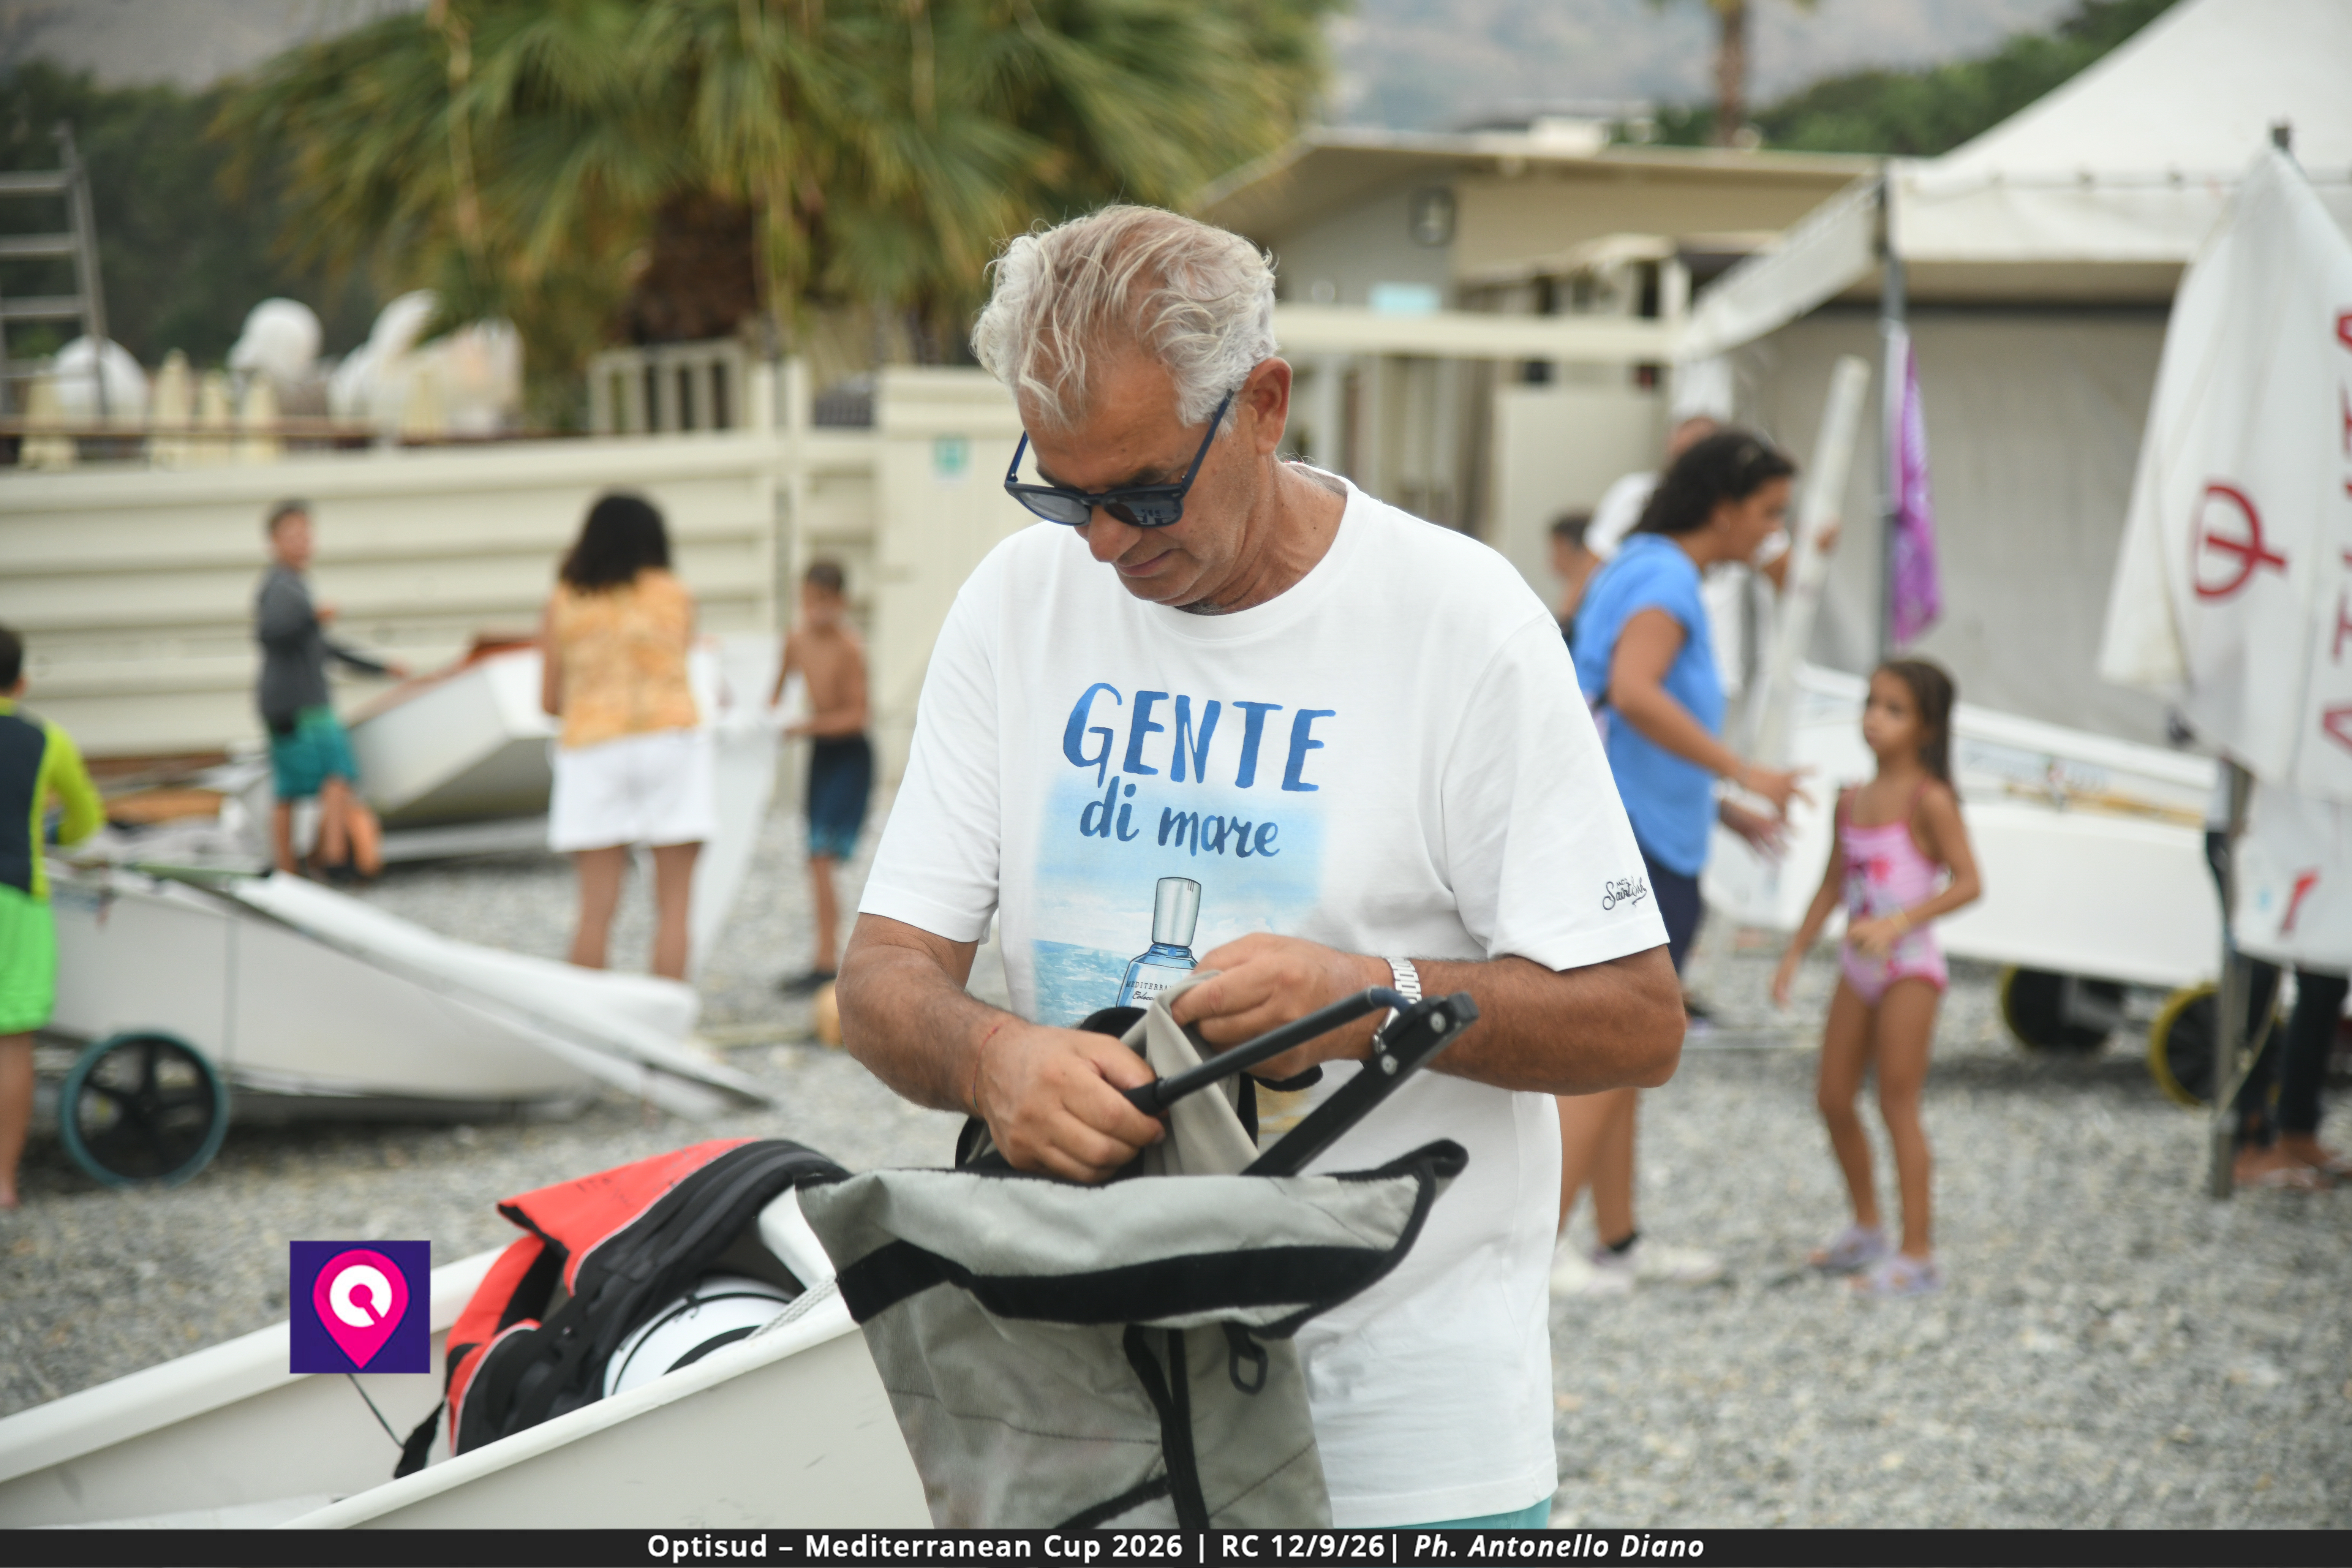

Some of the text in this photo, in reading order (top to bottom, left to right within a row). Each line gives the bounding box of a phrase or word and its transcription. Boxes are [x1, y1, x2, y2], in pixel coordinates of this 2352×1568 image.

[1063, 682, 1336, 792] GENTE
[1080, 776, 1280, 858] di mare
[1125, 981, 1173, 991] MEDITERRA
